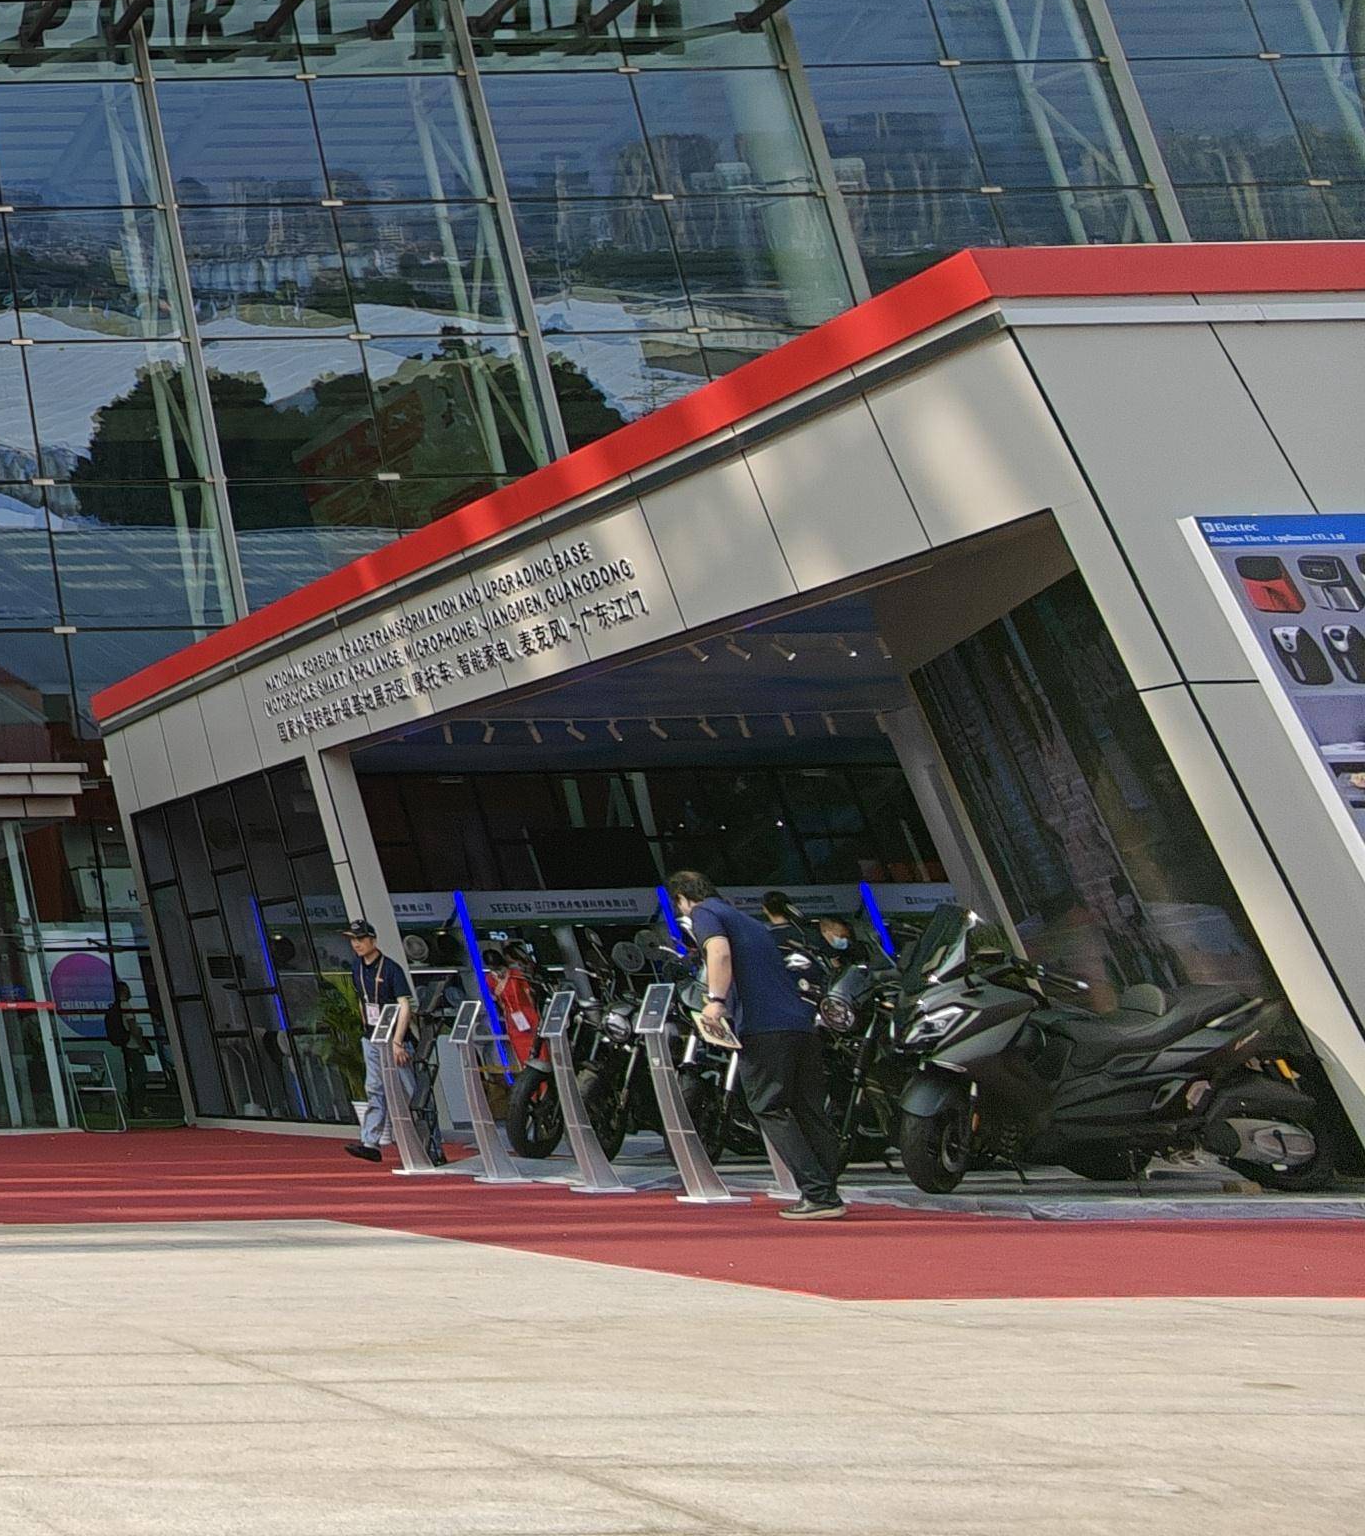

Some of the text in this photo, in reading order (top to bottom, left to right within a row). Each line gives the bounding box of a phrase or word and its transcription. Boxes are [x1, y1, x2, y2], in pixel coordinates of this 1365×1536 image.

[265, 541, 594, 692] NATIONAL FOREIGN TRADE TRANSFORMATION AND UPGRADING BASE
[318, 667, 348, 696] SMART
[545, 557, 635, 608] GUANGDONG
